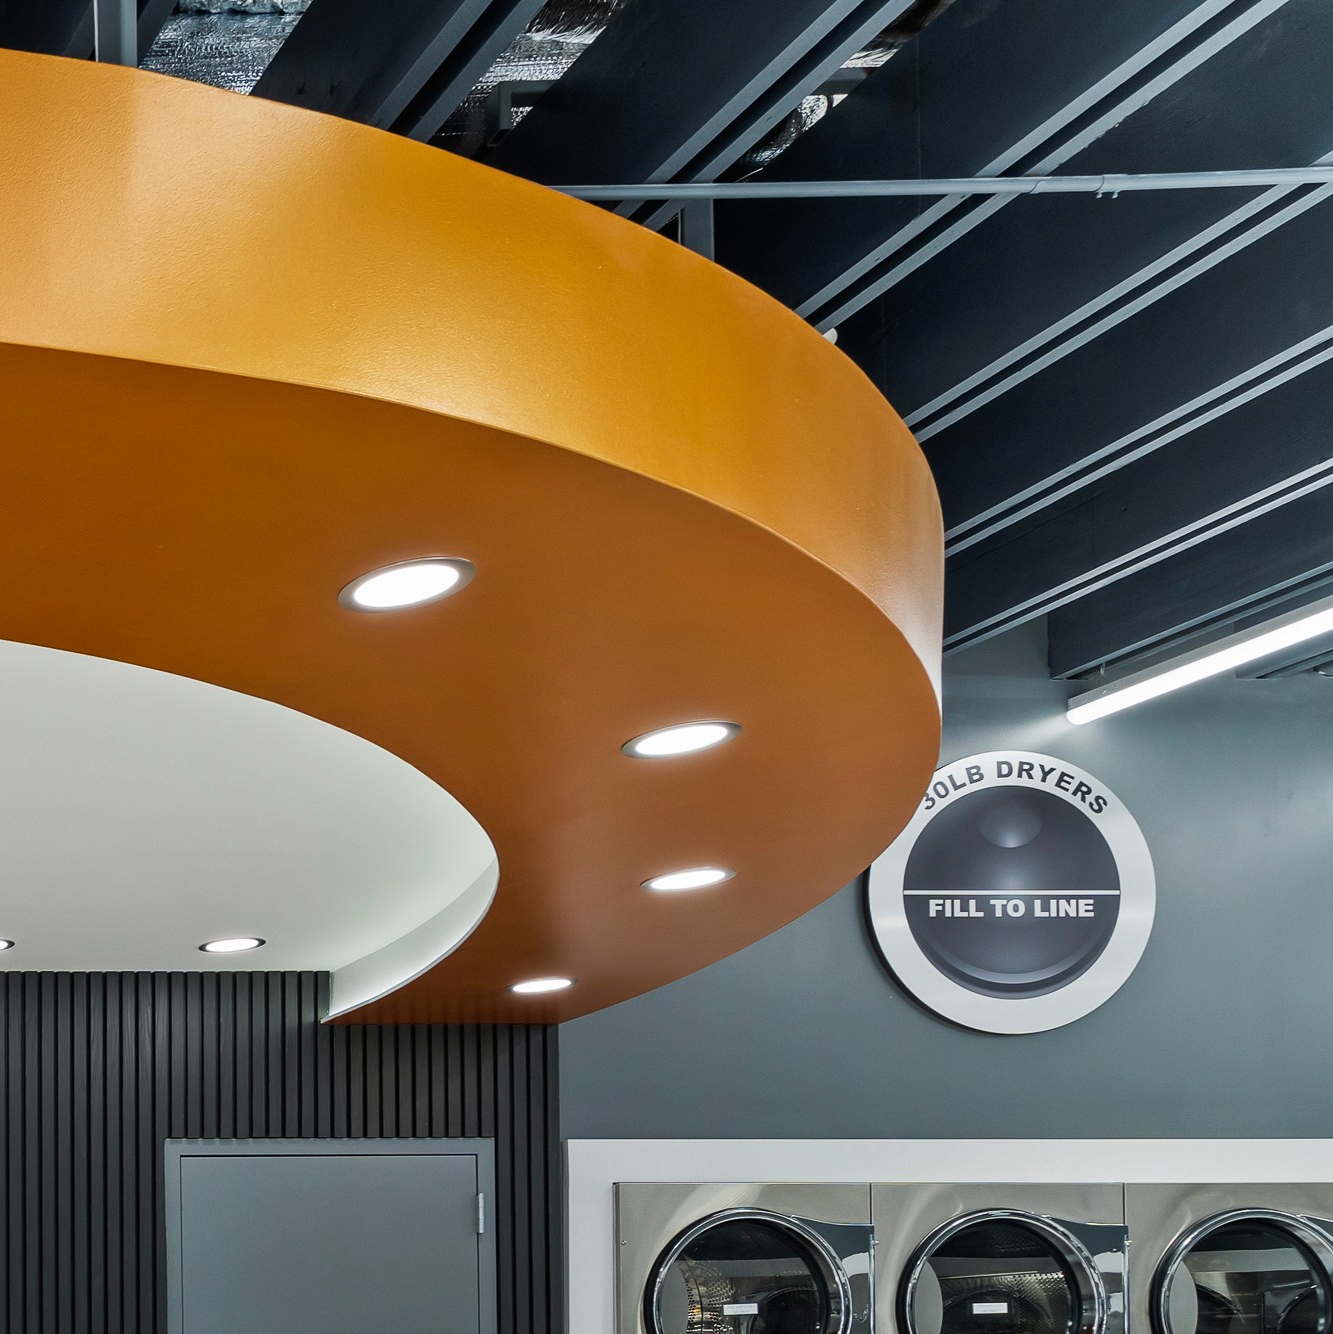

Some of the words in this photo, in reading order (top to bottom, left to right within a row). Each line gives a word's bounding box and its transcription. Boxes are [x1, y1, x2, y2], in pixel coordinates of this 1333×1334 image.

[996, 760, 1108, 814] DRYERS
[929, 899, 984, 917] FILL
[990, 899, 1026, 918] TO
[1033, 899, 1095, 917] LINE
